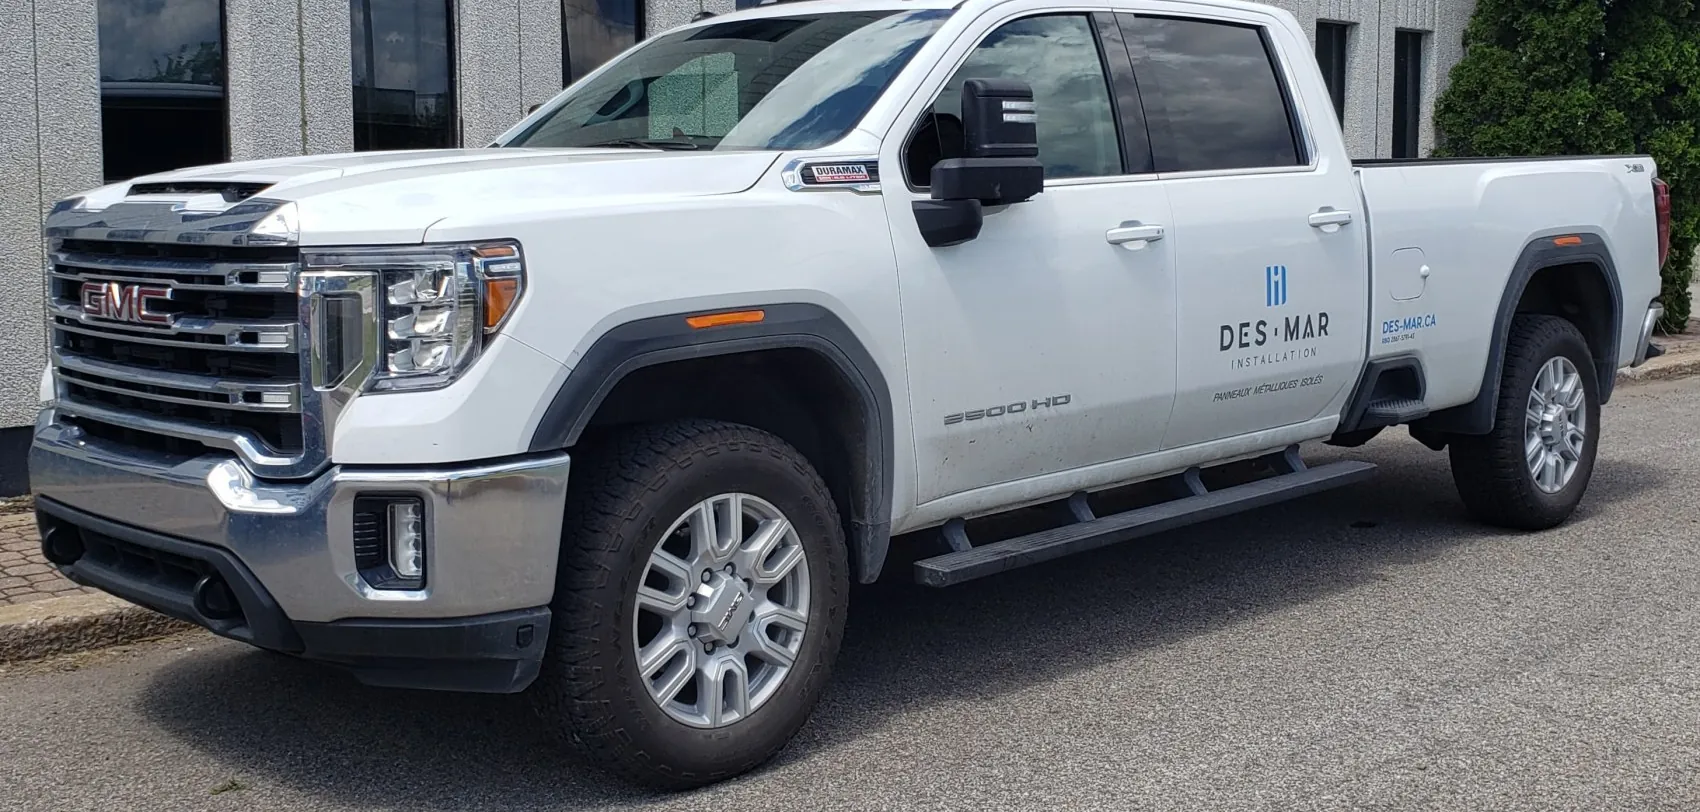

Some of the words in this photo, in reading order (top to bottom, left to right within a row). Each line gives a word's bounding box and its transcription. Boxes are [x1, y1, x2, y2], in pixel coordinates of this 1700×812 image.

[815, 166, 864, 175] DURAMAX
[81, 282, 174, 325] GMC
[1382, 313, 1437, 334] DES-MAR.CA
[1231, 347, 1318, 370] INSTALLATION
[1213, 387, 1252, 402] PANNEAUX
[1253, 379, 1299, 395] MÉTALLIQUES
[1300, 373, 1324, 388] ISOLÉS
[1031, 394, 1071, 410] HD
